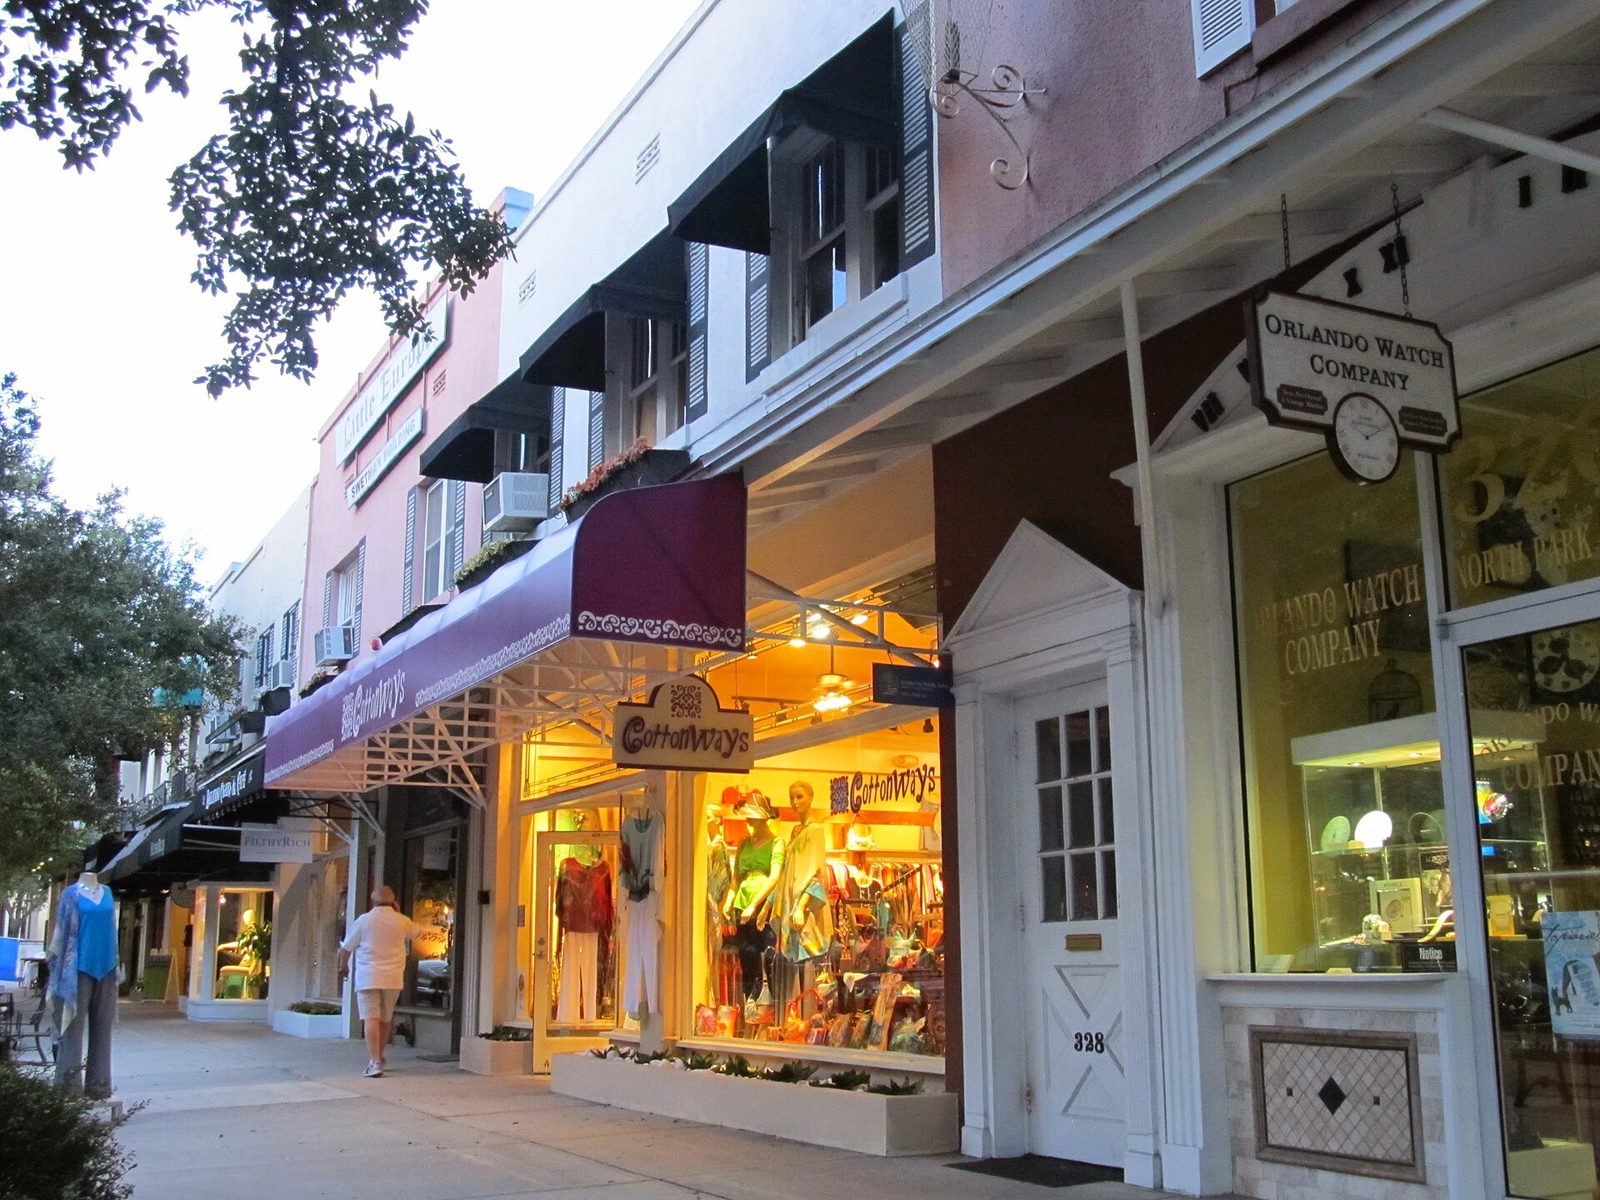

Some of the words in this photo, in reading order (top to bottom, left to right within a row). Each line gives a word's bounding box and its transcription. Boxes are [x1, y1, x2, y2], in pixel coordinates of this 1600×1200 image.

[1264, 313, 1370, 353] ORLANDO
[1376, 337, 1445, 369] WATCH
[343, 396, 376, 446] Little
[381, 338, 438, 399] Europ
[1309, 354, 1410, 392] COMPANY
[383, 419, 416, 460] BUILDING
[1458, 541, 1526, 589] NORTH
[1533, 523, 1593, 571] PARK
[1343, 564, 1422, 618] WATCH
[1284, 618, 1382, 676] COMPANY
[622, 714, 750, 759] CottonWays
[849, 763, 937, 815] CottonWays
[1501, 748, 1600, 792] COMPAN
[1418, 947, 1444, 960] Notice
[1074, 1031, 1105, 1054] 328
